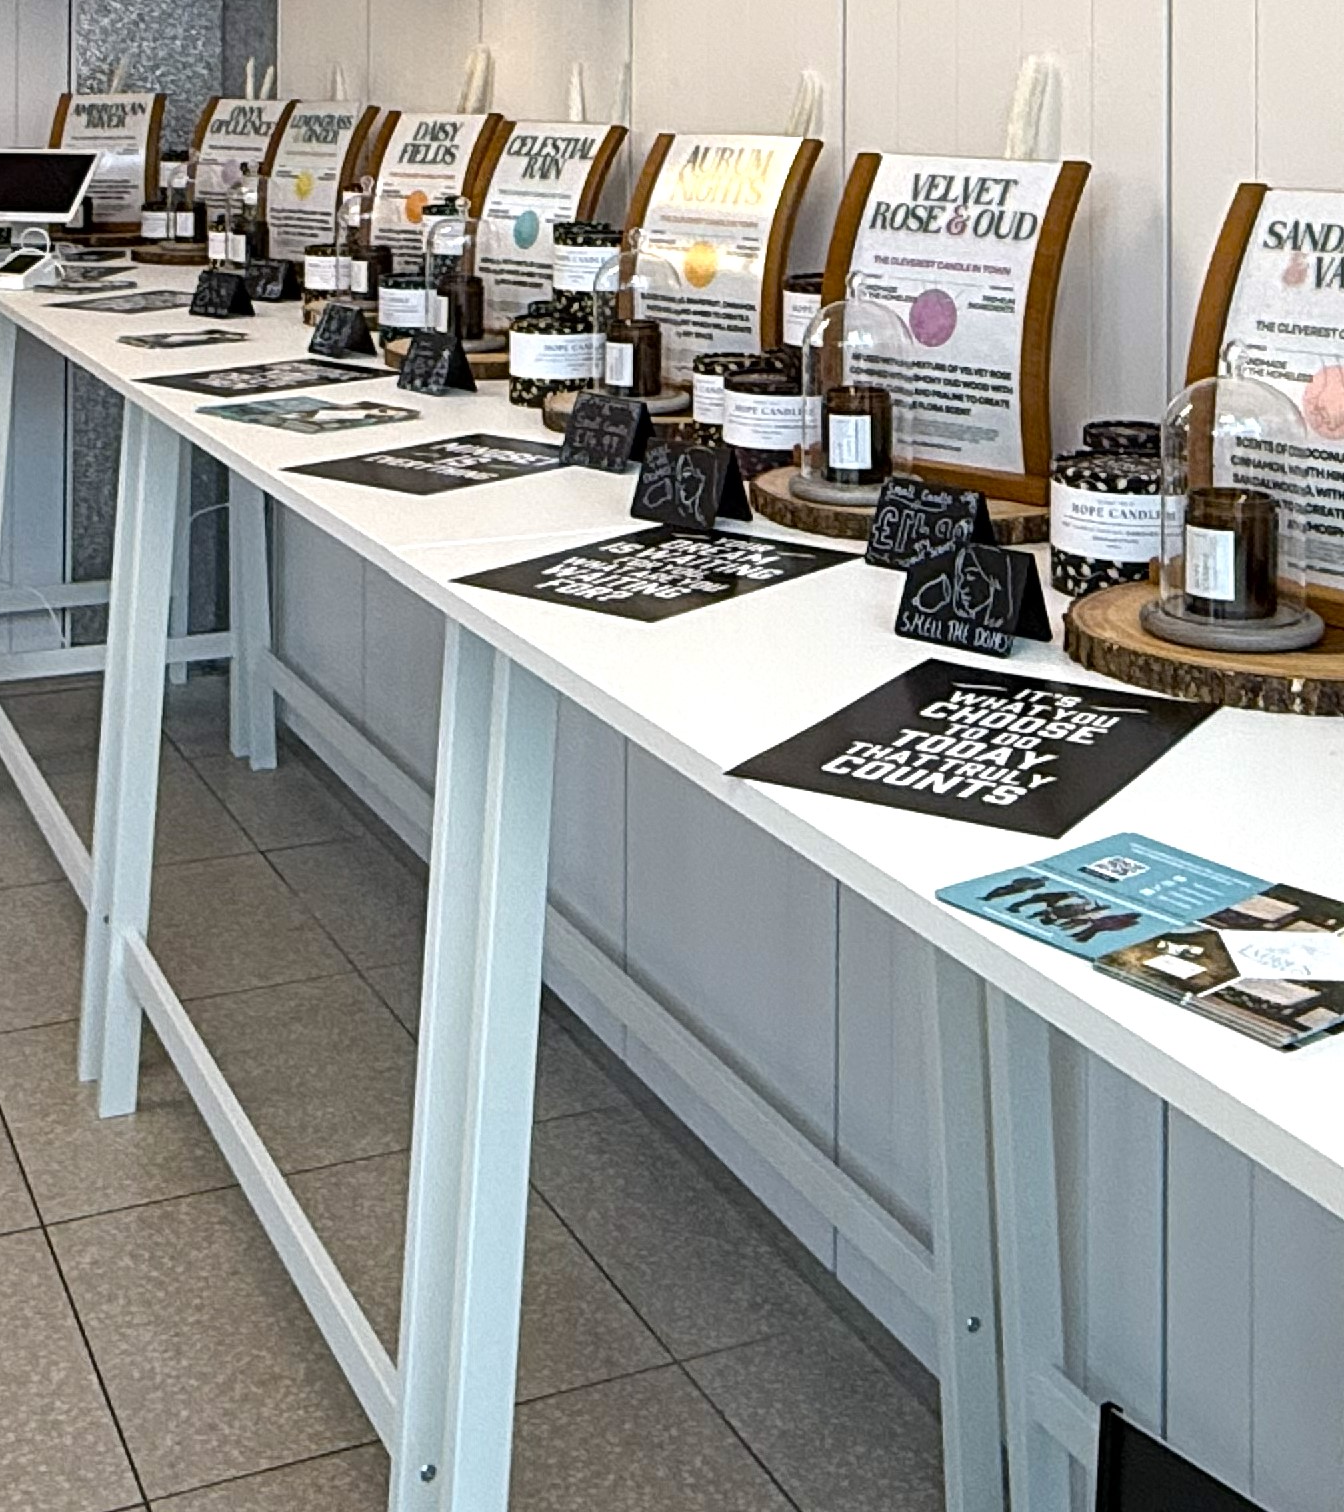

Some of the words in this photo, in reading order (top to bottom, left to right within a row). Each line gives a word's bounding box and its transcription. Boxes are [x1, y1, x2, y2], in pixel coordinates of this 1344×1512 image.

[413, 121, 464, 143] DAISY
[507, 135, 598, 160] CELESTIAL
[398, 143, 460, 165] FIELDS
[522, 156, 567, 180] RAIN
[683, 144, 775, 179] AURUM
[911, 172, 1018, 208] VELVET
[869, 201, 945, 234] ROSE
[946, 204, 970, 236] &
[973, 209, 1039, 241] OUD
[1256, 320, 1276, 334] THE
[1277, 322, 1339, 340] CLEVEREST
[1072, 502, 1105, 518] HOPE
[625, 547, 783, 579] WAITING
[900, 610, 943, 640] SMELL
[948, 619, 969, 644] THE
[949, 690, 1051, 715] WHAT
[1052, 708, 1119, 728] YOU
[1014, 688, 1081, 707] IT'S
[919, 701, 1107, 744] CHOOSE
[944, 722, 989, 739] TO
[990, 732, 1041, 749] DO
[845, 740, 939, 767] THAT
[938, 758, 1056, 788] TRULY
[891, 728, 1057, 769] TODAY
[820, 754, 1027, 805] COUNTS
